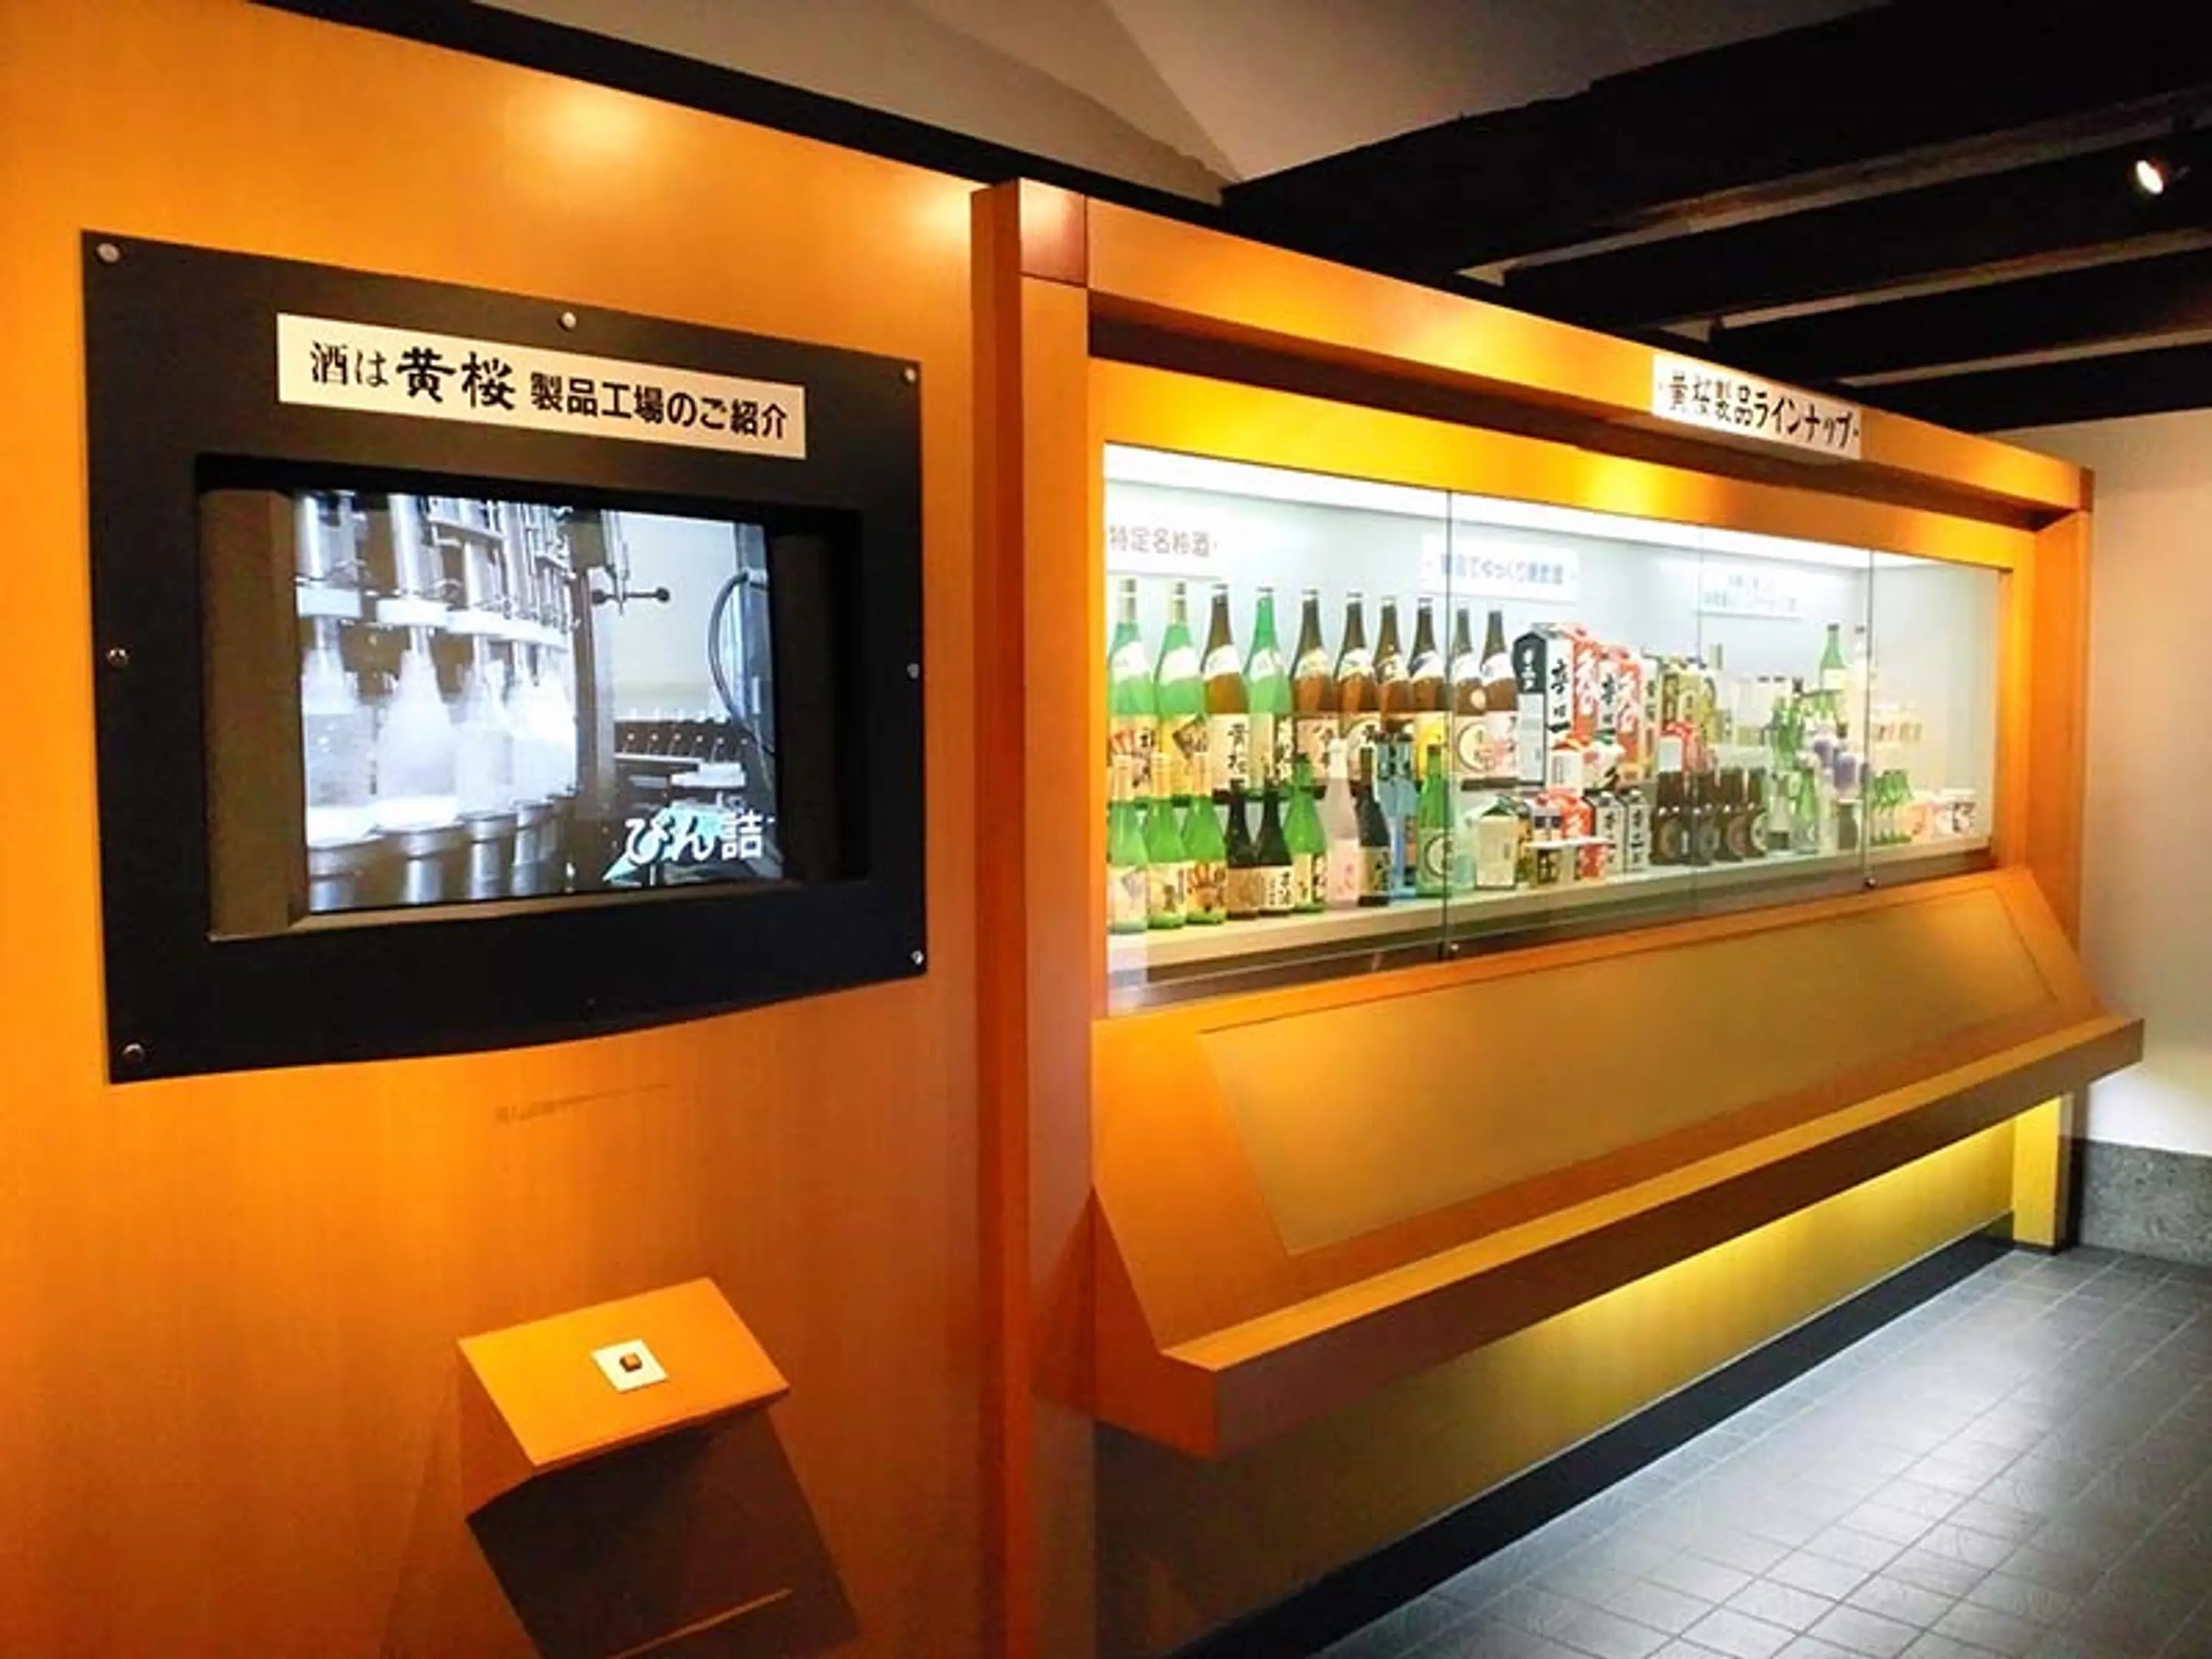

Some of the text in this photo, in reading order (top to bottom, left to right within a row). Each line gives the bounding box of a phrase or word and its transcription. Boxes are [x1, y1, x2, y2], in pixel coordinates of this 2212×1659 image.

[310, 341, 789, 440] 酒は黄桜 製品工場のご紹介
[624, 809, 763, 865] びん詰
